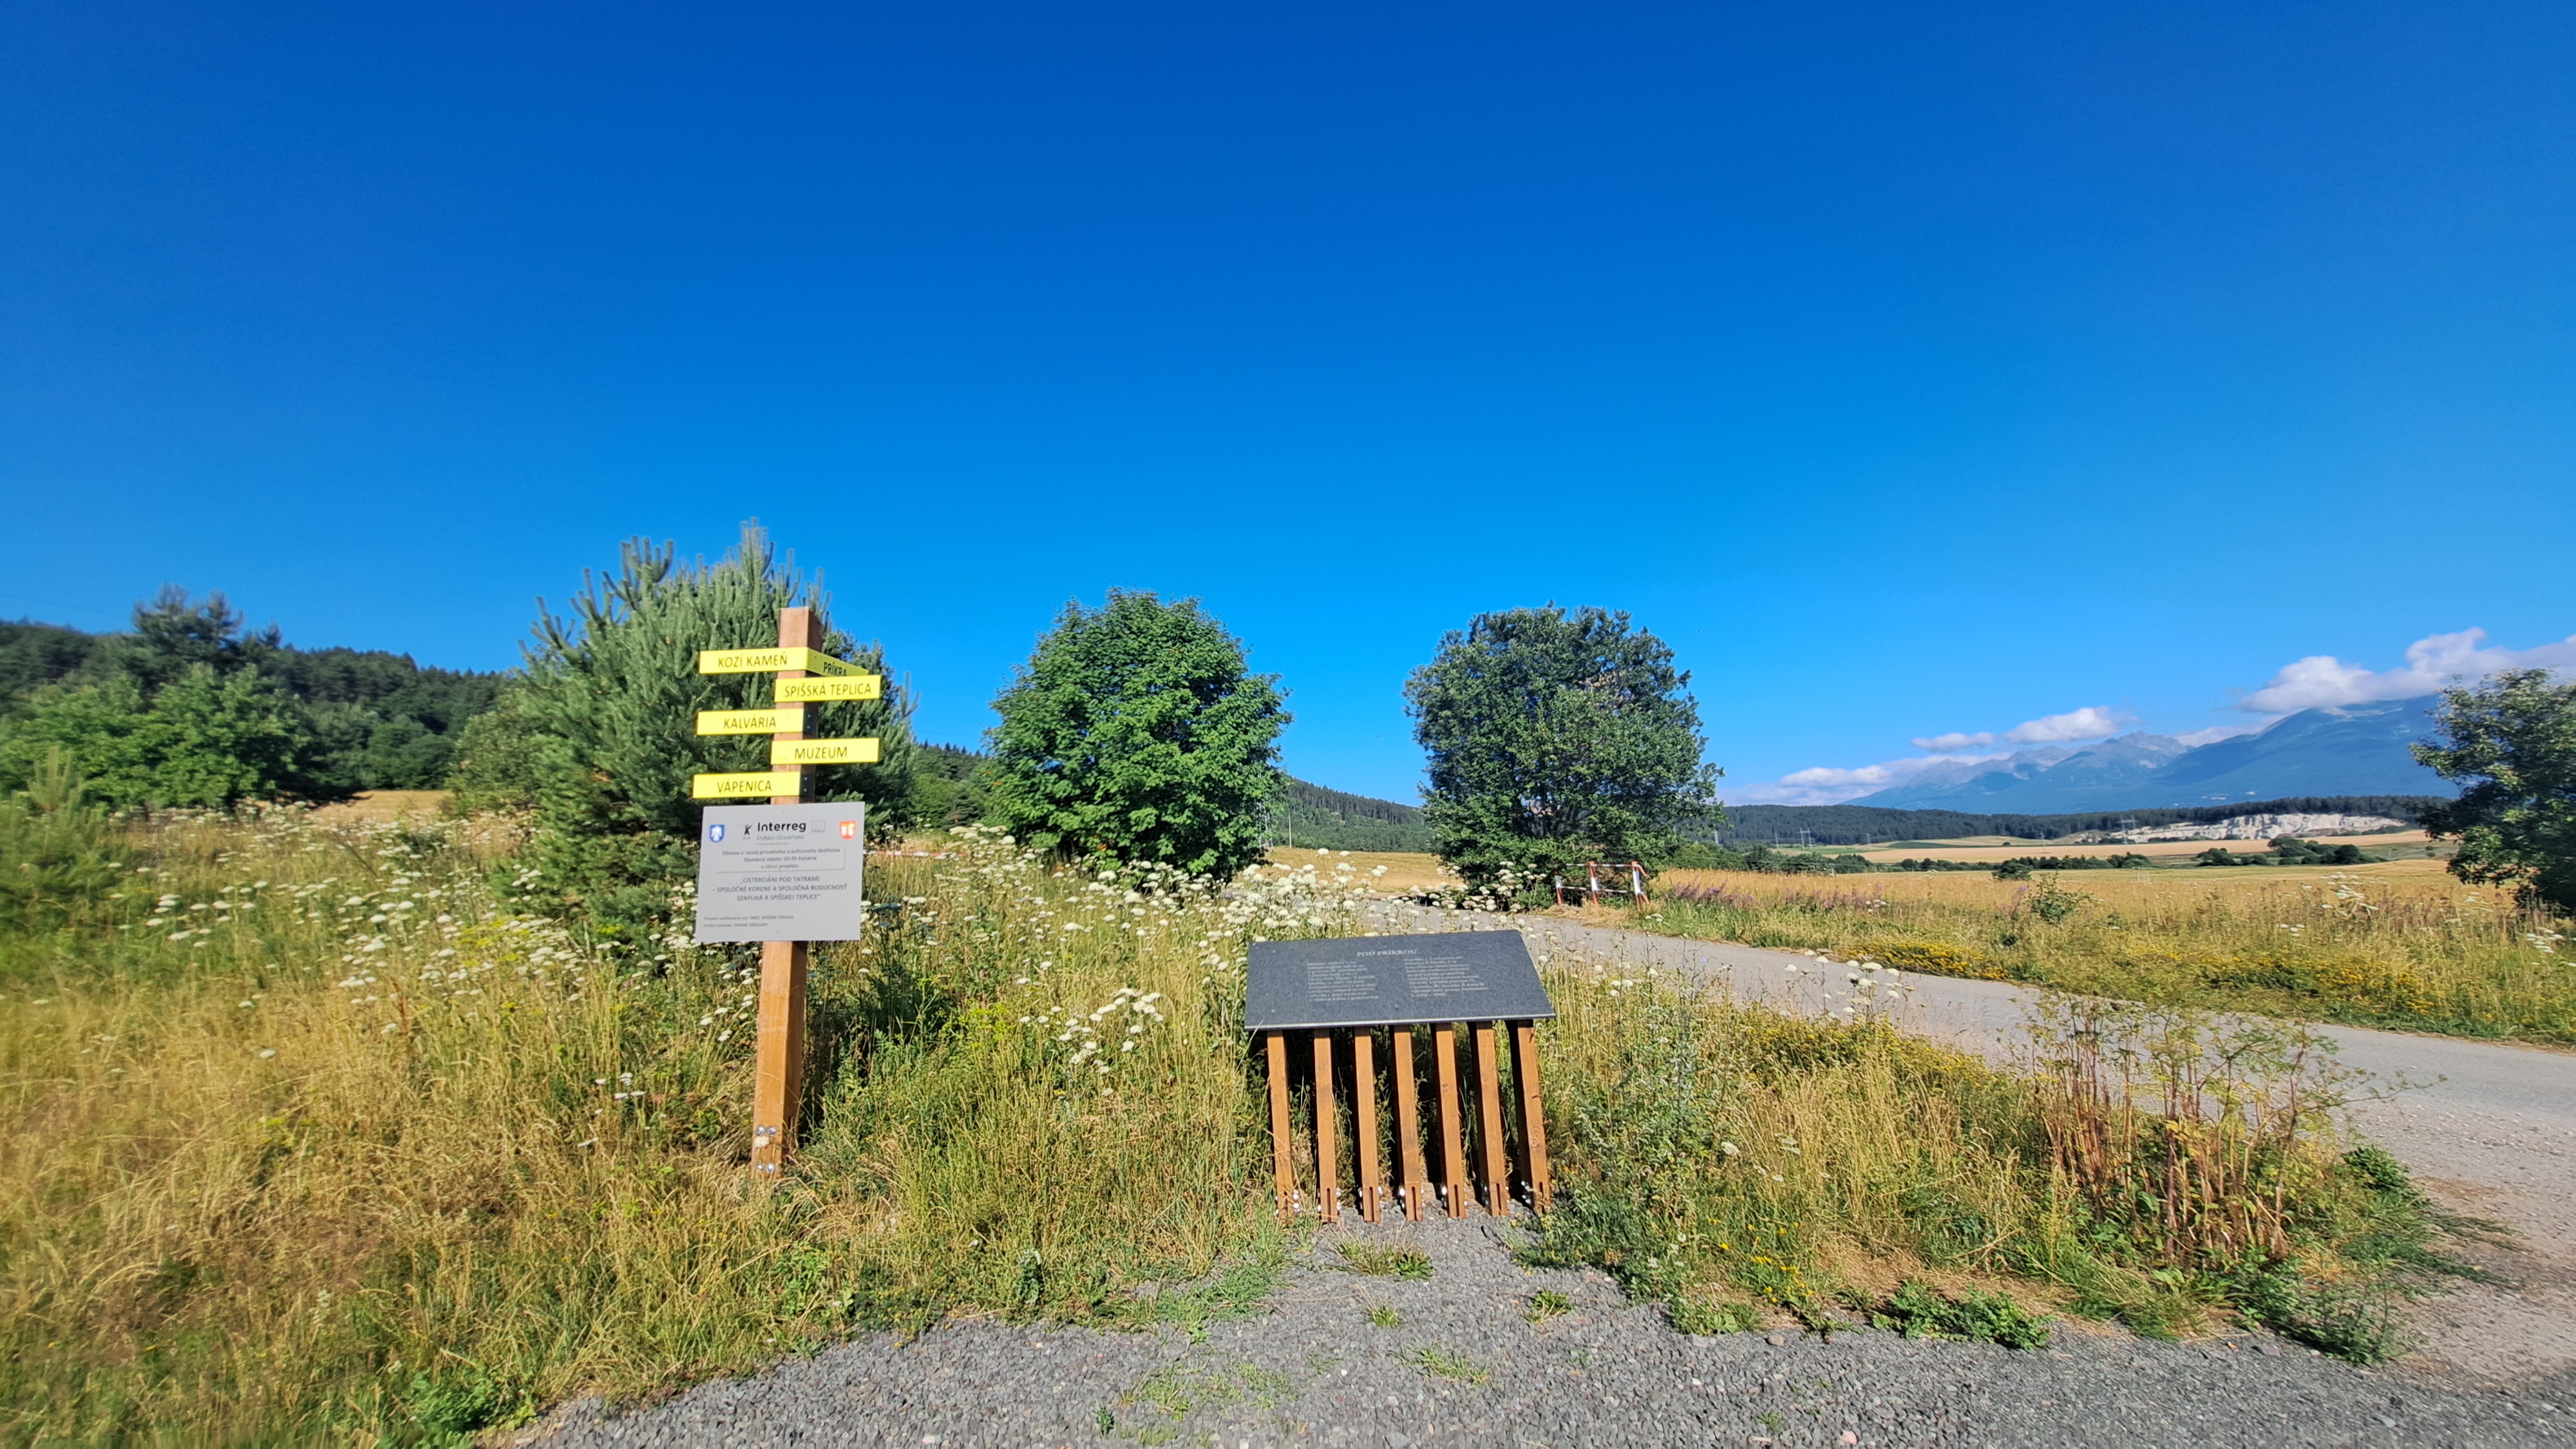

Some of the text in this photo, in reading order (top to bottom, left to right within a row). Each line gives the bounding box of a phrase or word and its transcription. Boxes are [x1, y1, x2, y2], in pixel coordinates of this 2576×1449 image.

[718, 651, 788, 668] KOZÍ KAMEŇ
[823, 661, 847, 676] PRÍKRA
[784, 682, 871, 697] SPIŠSKÁ TEPLICA
[724, 714, 776, 729] KALVÁRIA
[795, 744, 848, 759] MÚZEUM
[717, 778, 772, 793] VÁPENICA
[757, 822, 806, 833] Interreg
